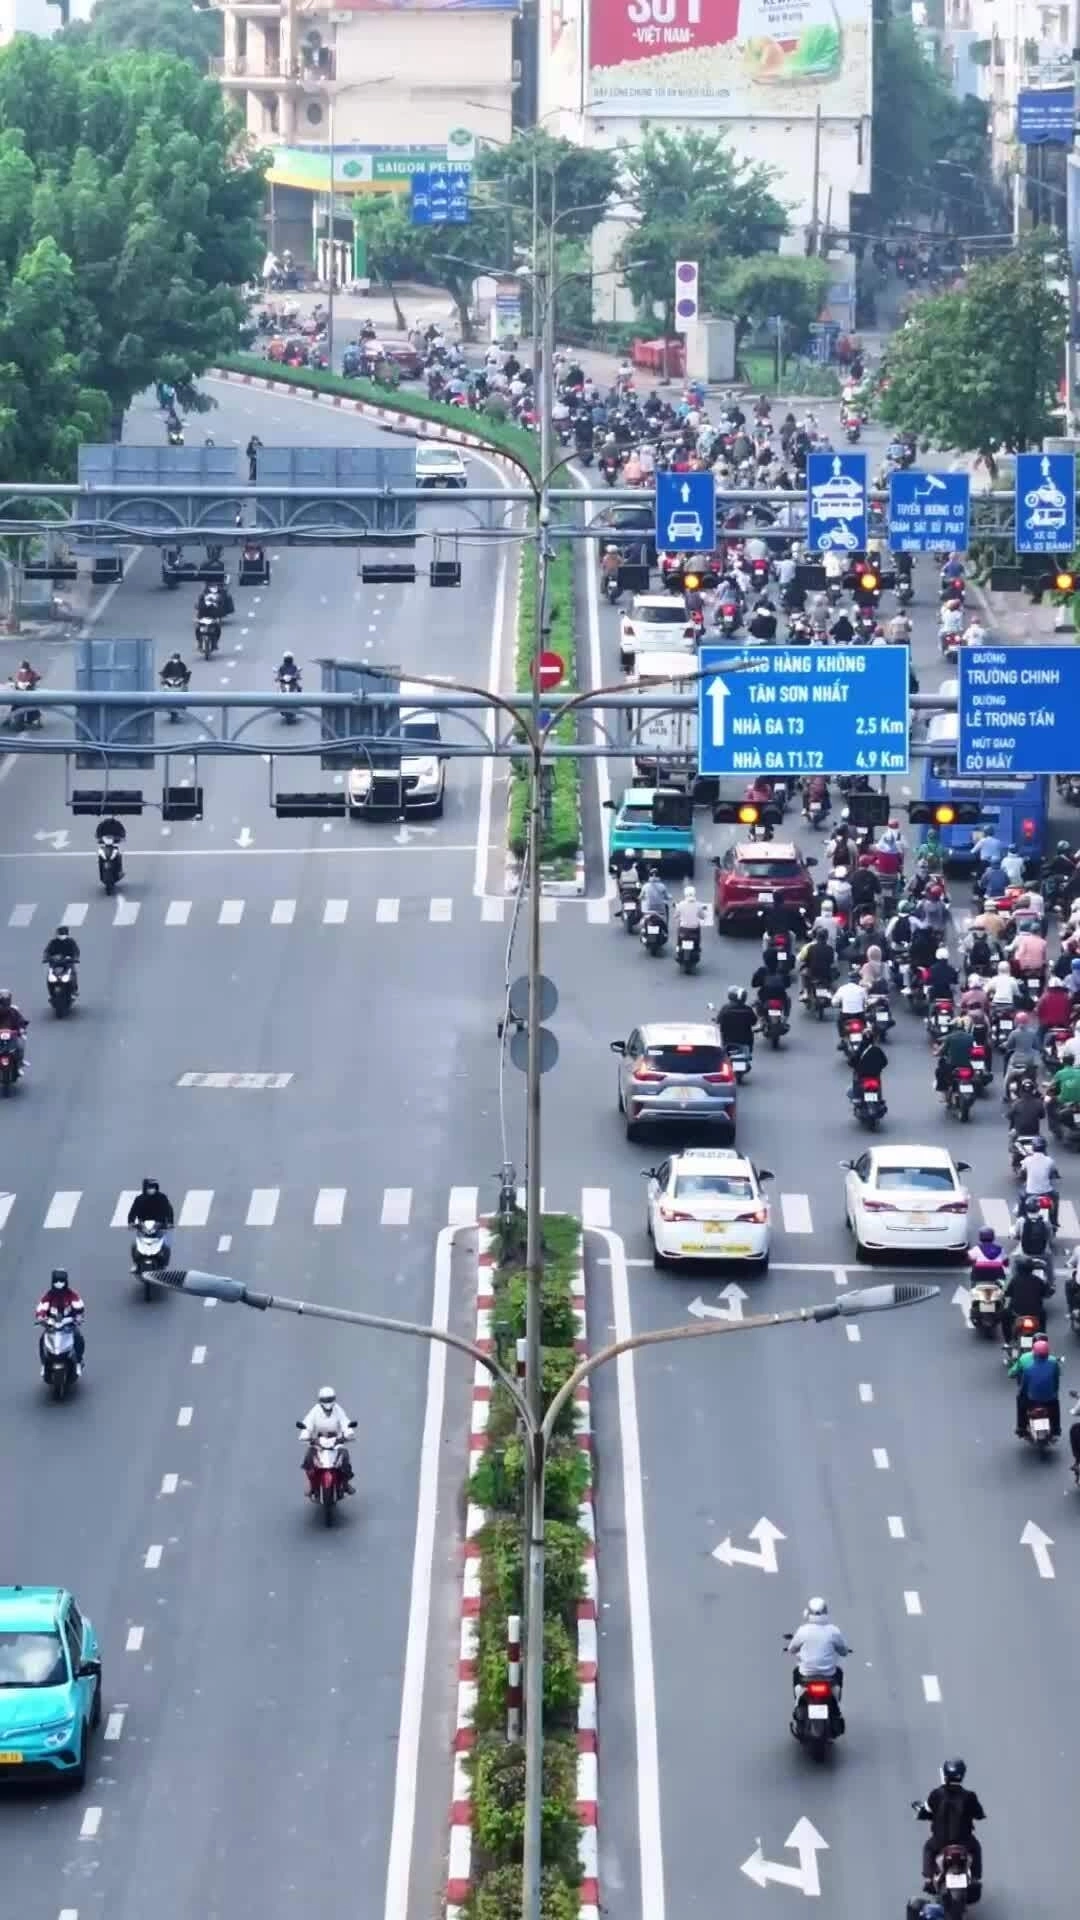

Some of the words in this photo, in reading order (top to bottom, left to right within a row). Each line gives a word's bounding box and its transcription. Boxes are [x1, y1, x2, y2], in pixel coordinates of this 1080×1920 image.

[377, 161, 425, 173] SAIGON
[774, 651, 812, 673] HÀNG
[816, 651, 866, 673] KHÔNG
[1020, 669, 1060, 685] CHINH
[749, 682, 776, 703] TÂN
[780, 685, 809, 703] SƠN
[812, 678, 849, 702] NHẤT
[733, 712, 762, 735] NHÀ
[765, 717, 784, 735] GA
[787, 717, 805, 735] T3
[880, 717, 904, 734] Km
[966, 708, 982, 727] LÊ
[984, 711, 1026, 729] TRỌNG
[733, 746, 762, 769] NHÀ
[765, 751, 784, 769] GA
[880, 751, 904, 768] Km
